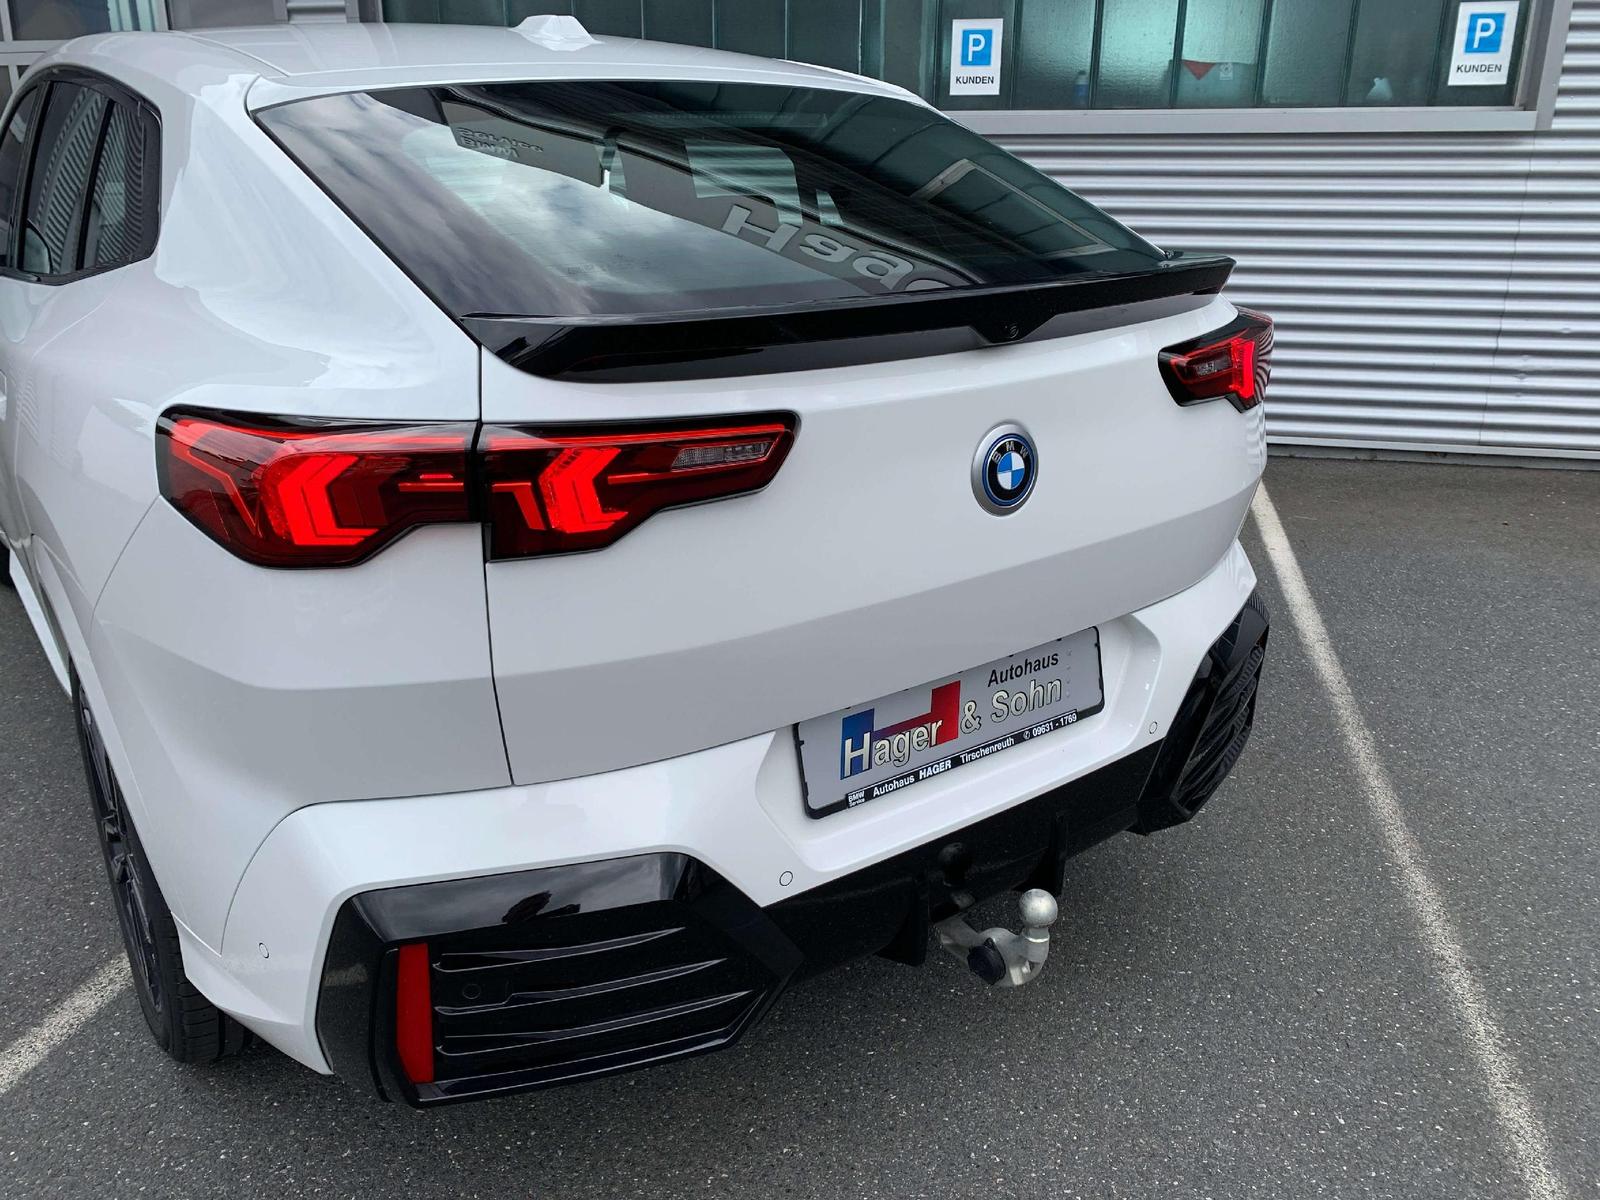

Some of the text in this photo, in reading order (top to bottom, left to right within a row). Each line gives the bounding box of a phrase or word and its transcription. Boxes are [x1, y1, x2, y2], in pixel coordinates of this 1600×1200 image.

[967, 33, 986, 62] P
[1472, 17, 1497, 49] P
[955, 75, 995, 85] KUNDEN
[1456, 63, 1503, 73] KUNDEN
[992, 440, 1028, 464] BMW
[987, 652, 1060, 688] Autohaus
[842, 678, 1062, 780] Hager & Sohn
[873, 774, 915, 798] Autohaus
[919, 759, 952, 781] HAGER
[960, 737, 1015, 764] Tirschenreuth
[1032, 721, 1054, 737] 09631
[1060, 712, 1077, 726] 1769
[848, 790, 865, 803] BMW
